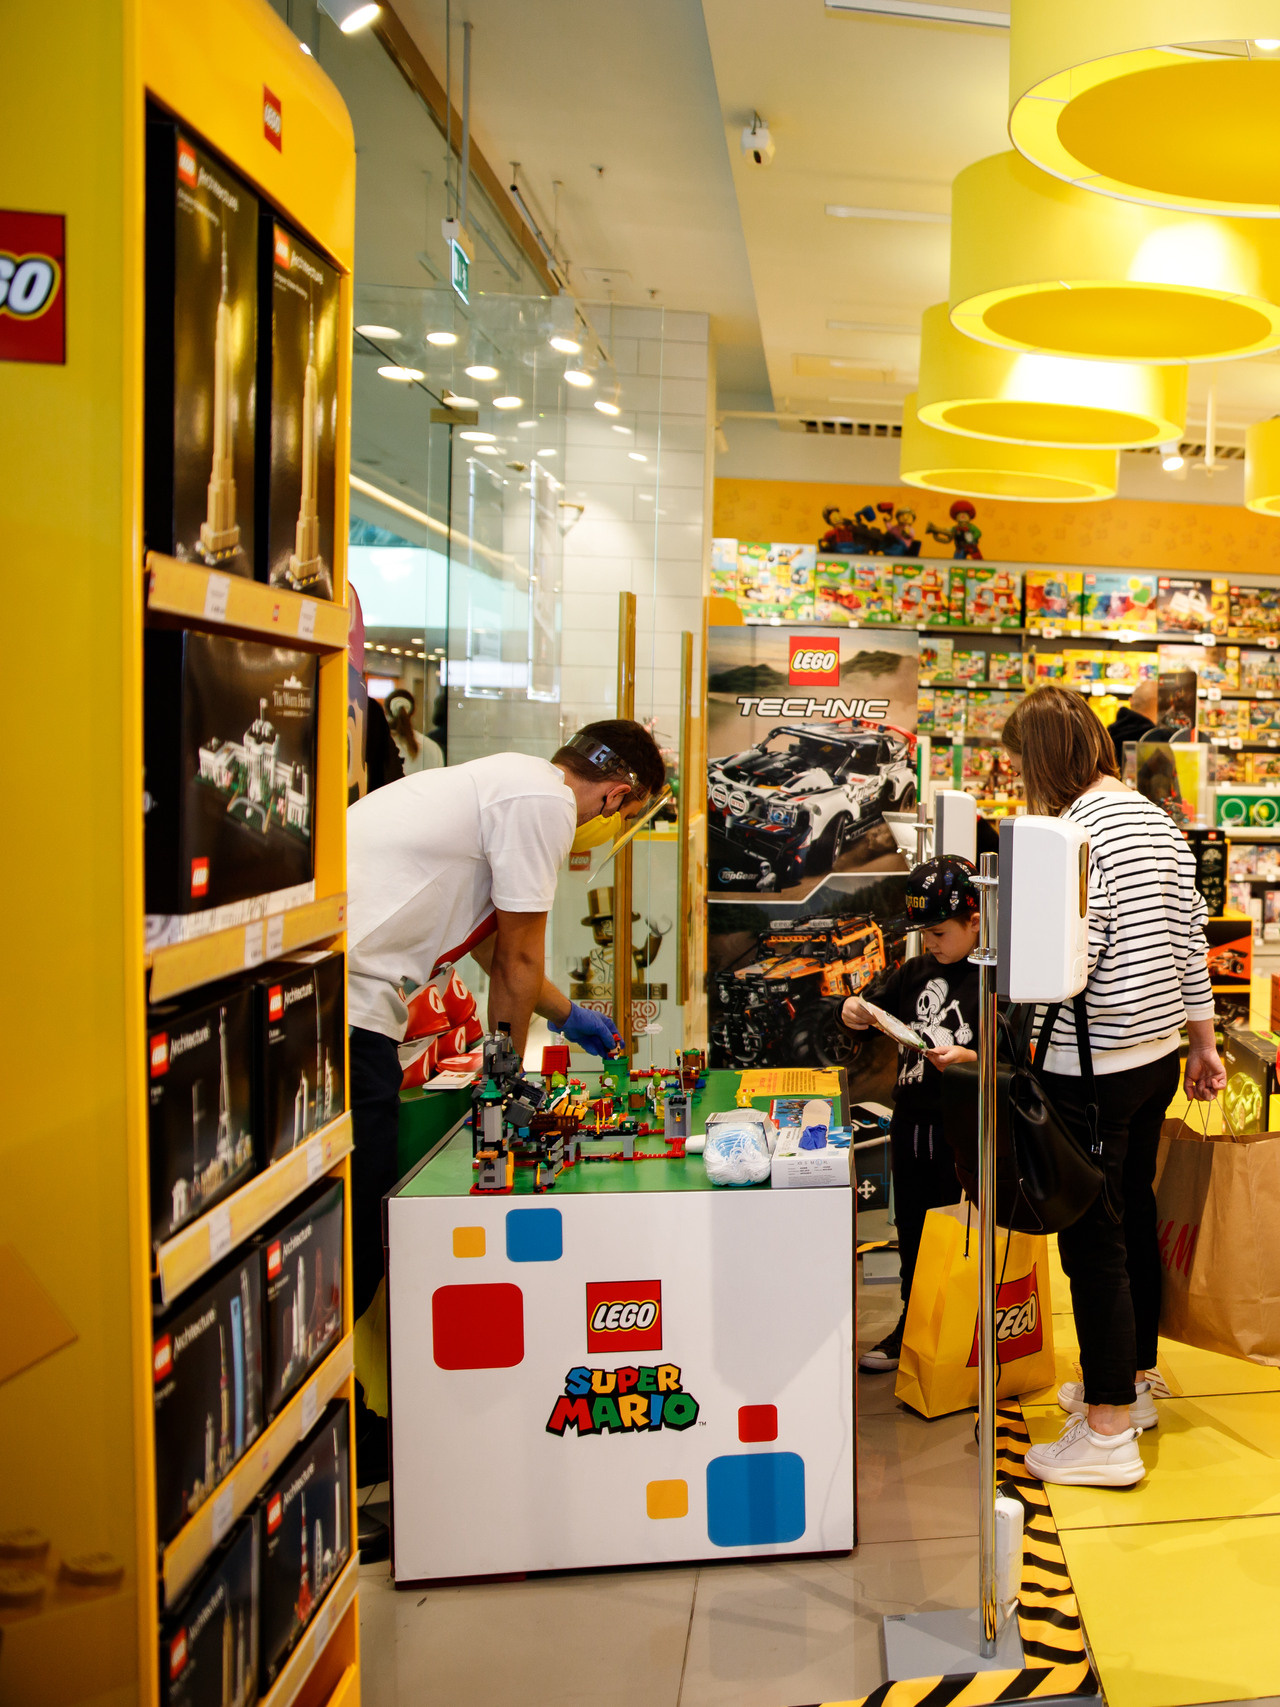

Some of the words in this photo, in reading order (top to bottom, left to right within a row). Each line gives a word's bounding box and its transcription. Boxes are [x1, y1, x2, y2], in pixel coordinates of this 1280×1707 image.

[792, 650, 837, 672] LEGO
[736, 696, 890, 719] TECHNIC
[592, 1302, 658, 1331] LEGO
[996, 1293, 1038, 1342] EGO
[565, 1363, 683, 1396] SUPER
[546, 1393, 700, 1438] MARIO
